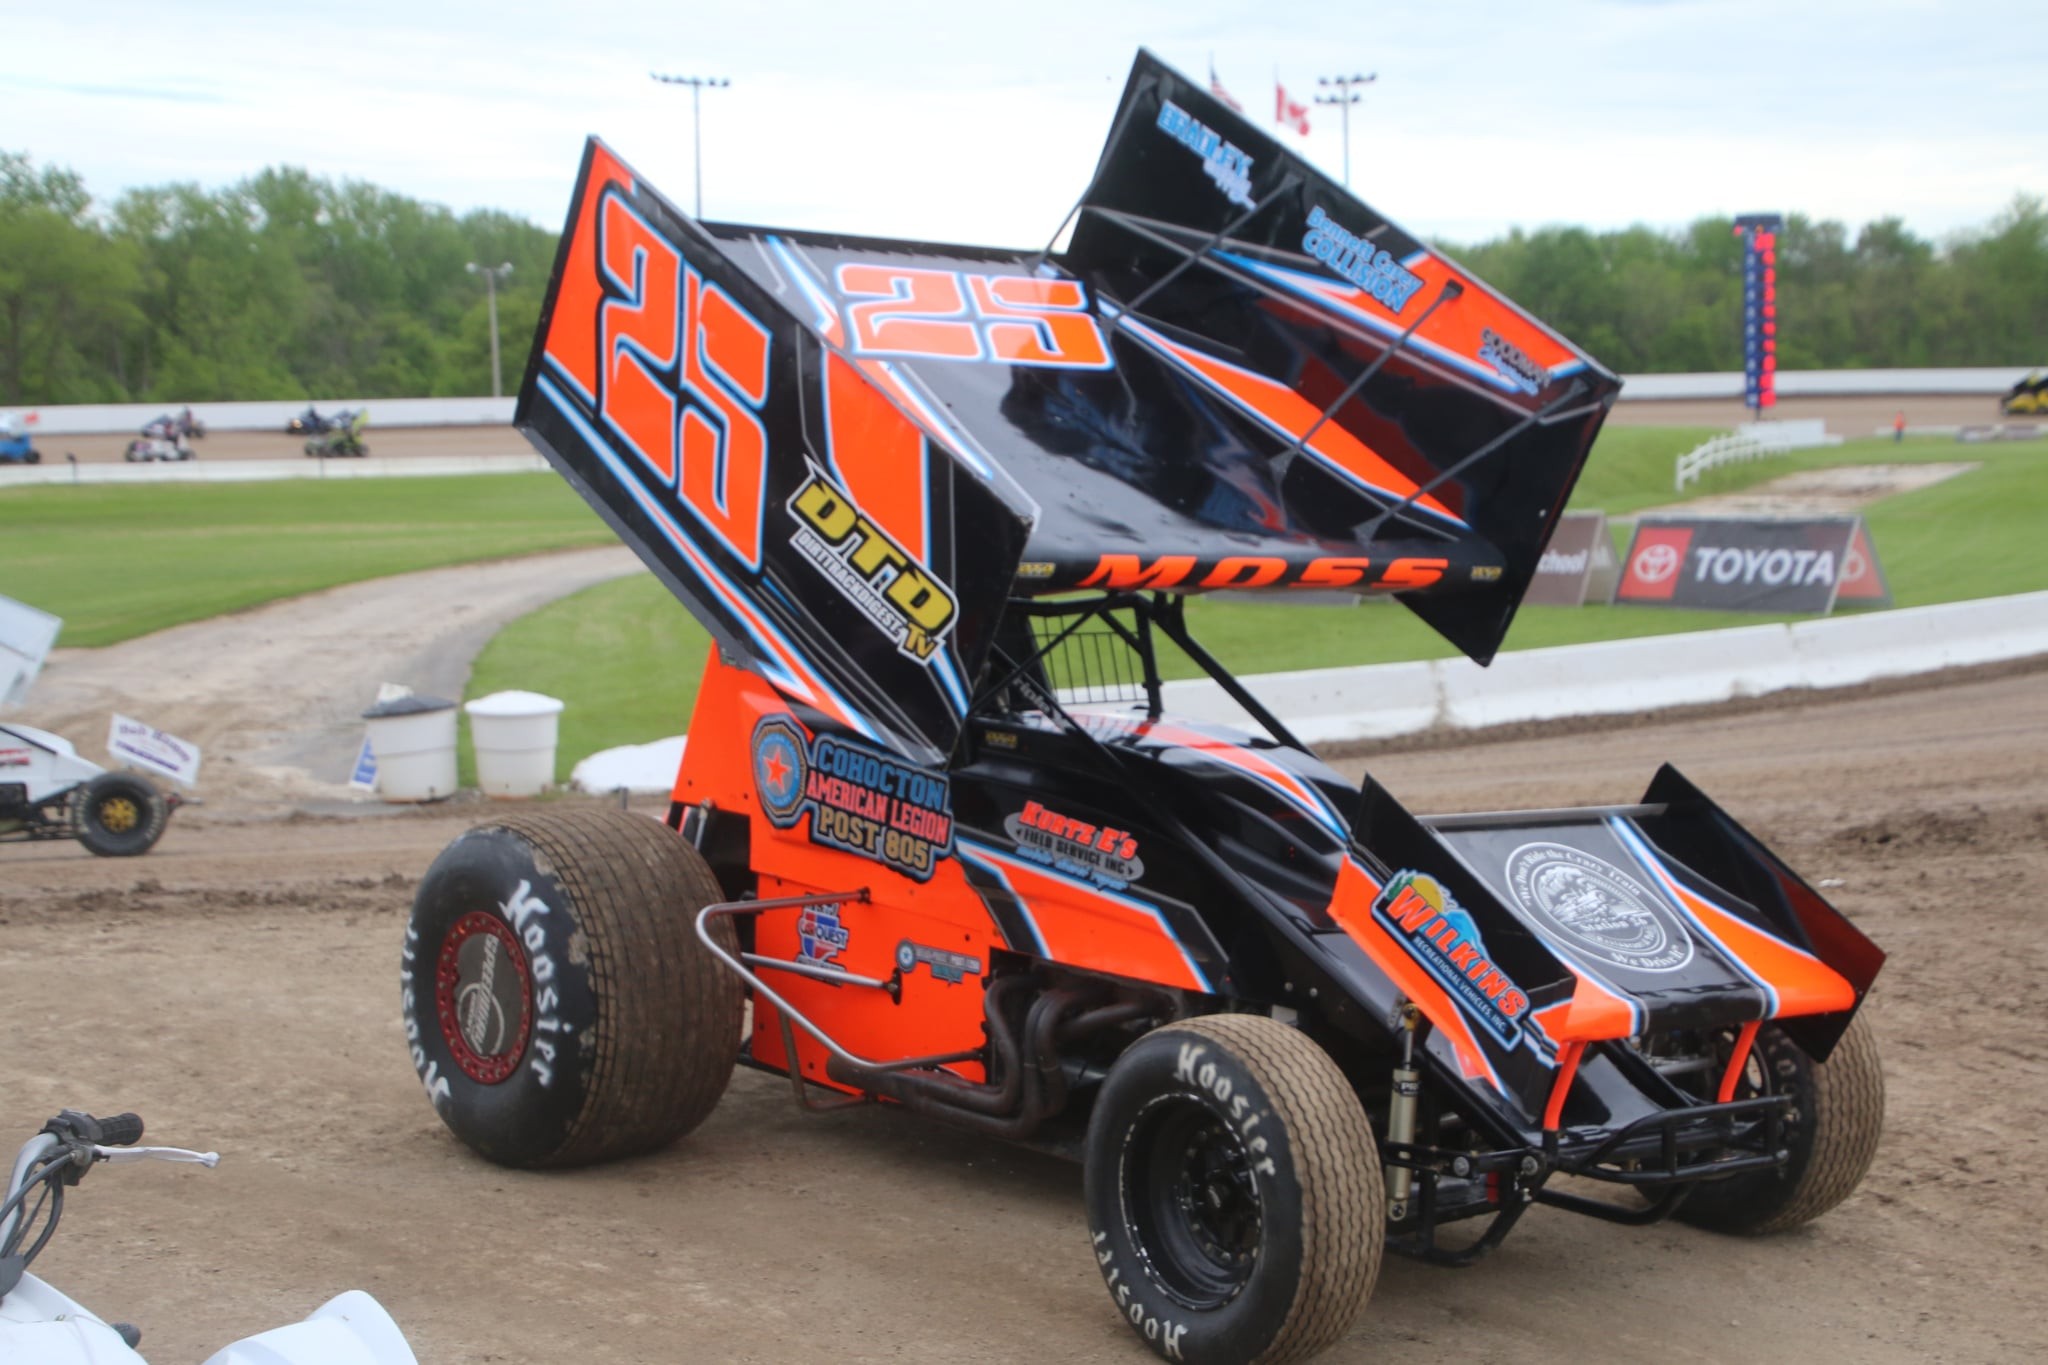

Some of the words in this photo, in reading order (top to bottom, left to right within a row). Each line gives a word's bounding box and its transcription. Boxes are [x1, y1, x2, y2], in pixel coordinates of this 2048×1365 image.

[1302, 228, 1408, 315] COLLISION
[834, 263, 1115, 370] 25
[601, 191, 772, 572] 25
[1078, 555, 1449, 588] MOSS
[1694, 547, 1835, 585] TOYOTA
[806, 770, 888, 824] AMERICAN
[889, 800, 950, 845] LEGION
[818, 743, 947, 812] COHOCTON
[819, 806, 880, 852] POST
[885, 829, 929, 870] 805
[1386, 884, 1526, 1017] WILKINS
[1412, 936, 1461, 983] RECREATIONAL
[1173, 1042, 1276, 1176] Hoosier
[1092, 1230, 1188, 1362] Hoosier
